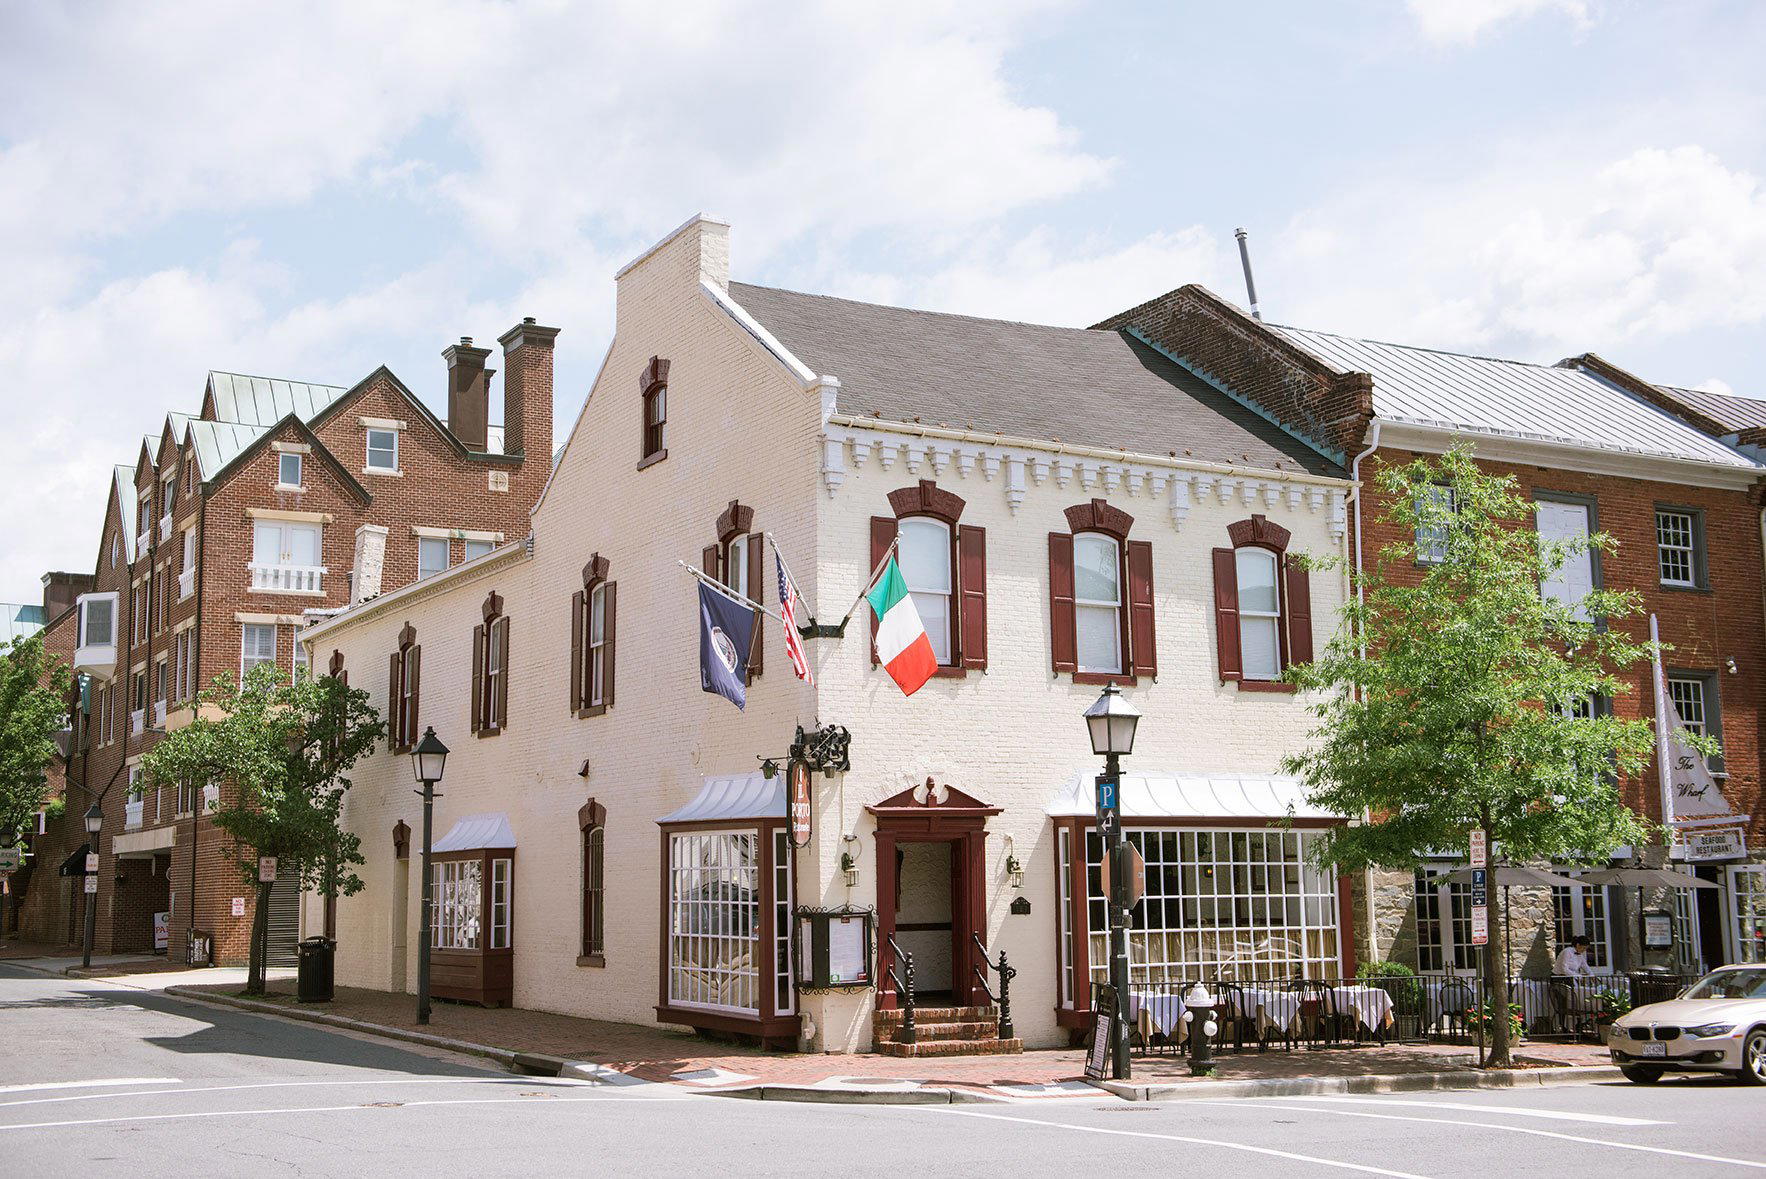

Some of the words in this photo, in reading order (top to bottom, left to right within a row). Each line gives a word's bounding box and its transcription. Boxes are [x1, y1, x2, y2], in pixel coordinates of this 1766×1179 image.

[1675, 756, 1694, 770] The
[1102, 786, 1113, 807] P
[1677, 783, 1709, 802] Wharf
[792, 803, 810, 818] PORTO
[1701, 836, 1726, 845] SEAFOOD
[1695, 845, 1732, 854] RESTAURANT
[1476, 871, 1482, 882] P
